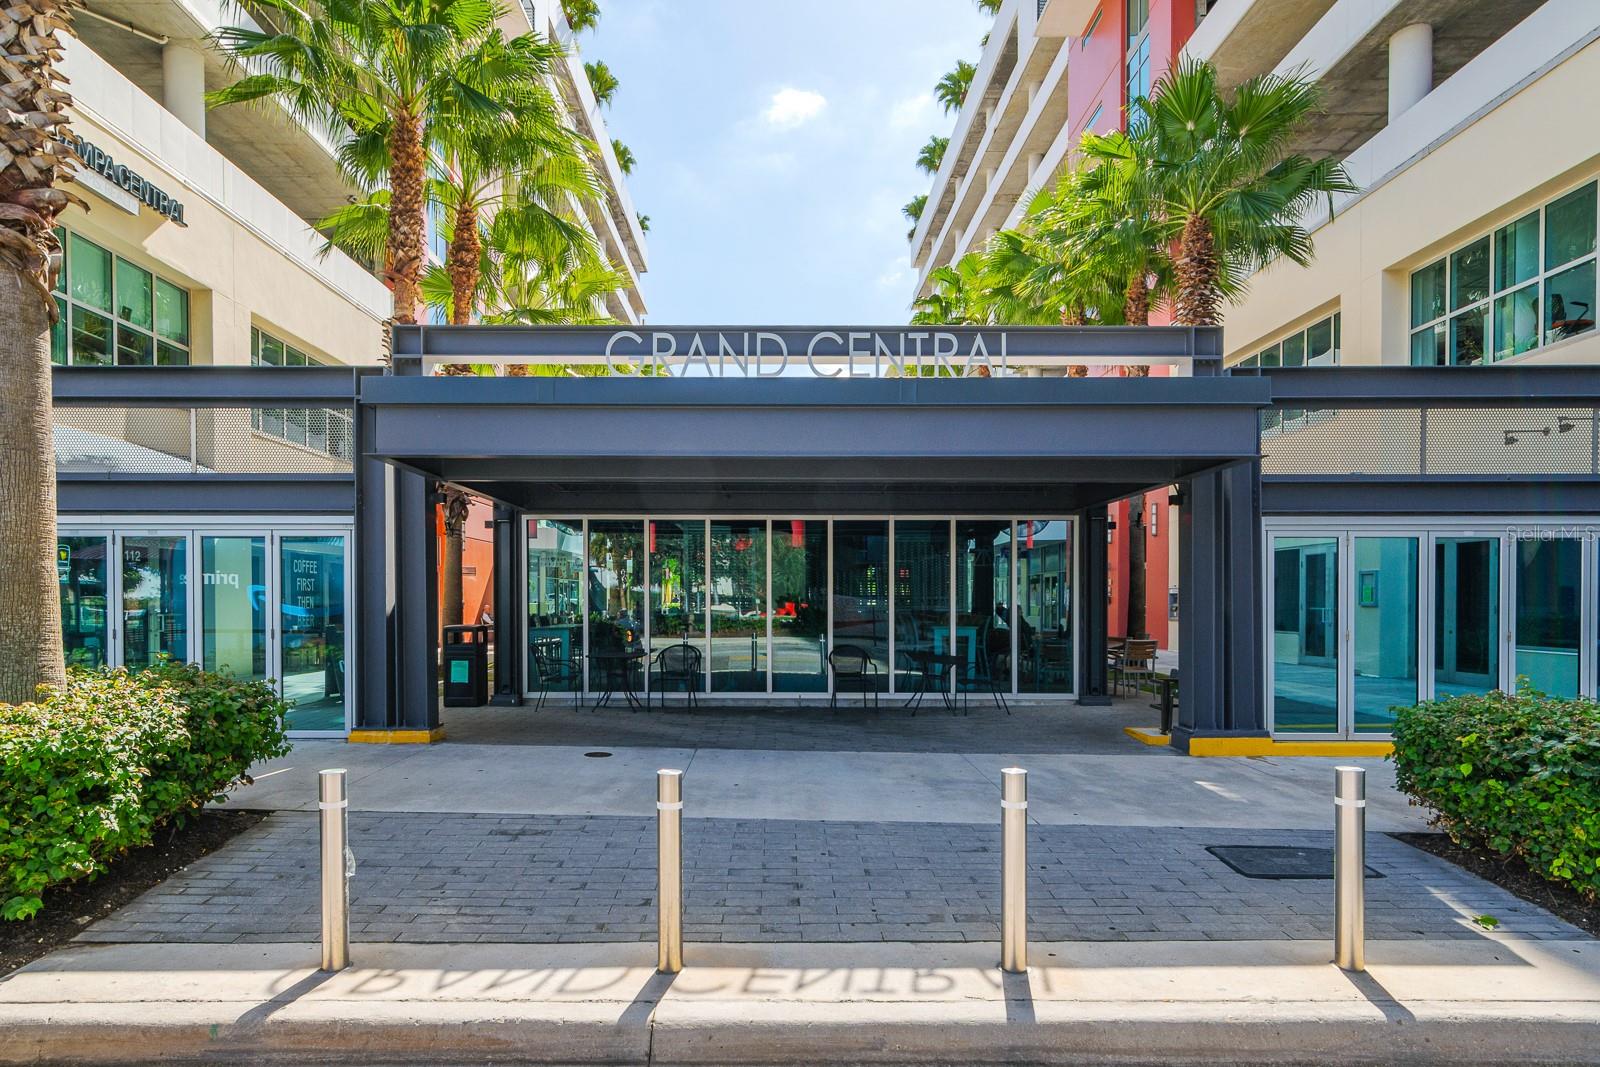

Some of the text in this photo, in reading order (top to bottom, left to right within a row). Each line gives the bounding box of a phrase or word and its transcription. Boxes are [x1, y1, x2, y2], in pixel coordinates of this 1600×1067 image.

[604, 330, 1016, 378] GRAND CENTRAL
[124, 550, 141, 562] 112
[293, 559, 318, 574] COFFEE
[296, 577, 315, 592] FIRST
[297, 595, 315, 609] THEN
[297, 614, 315, 628] BEER
